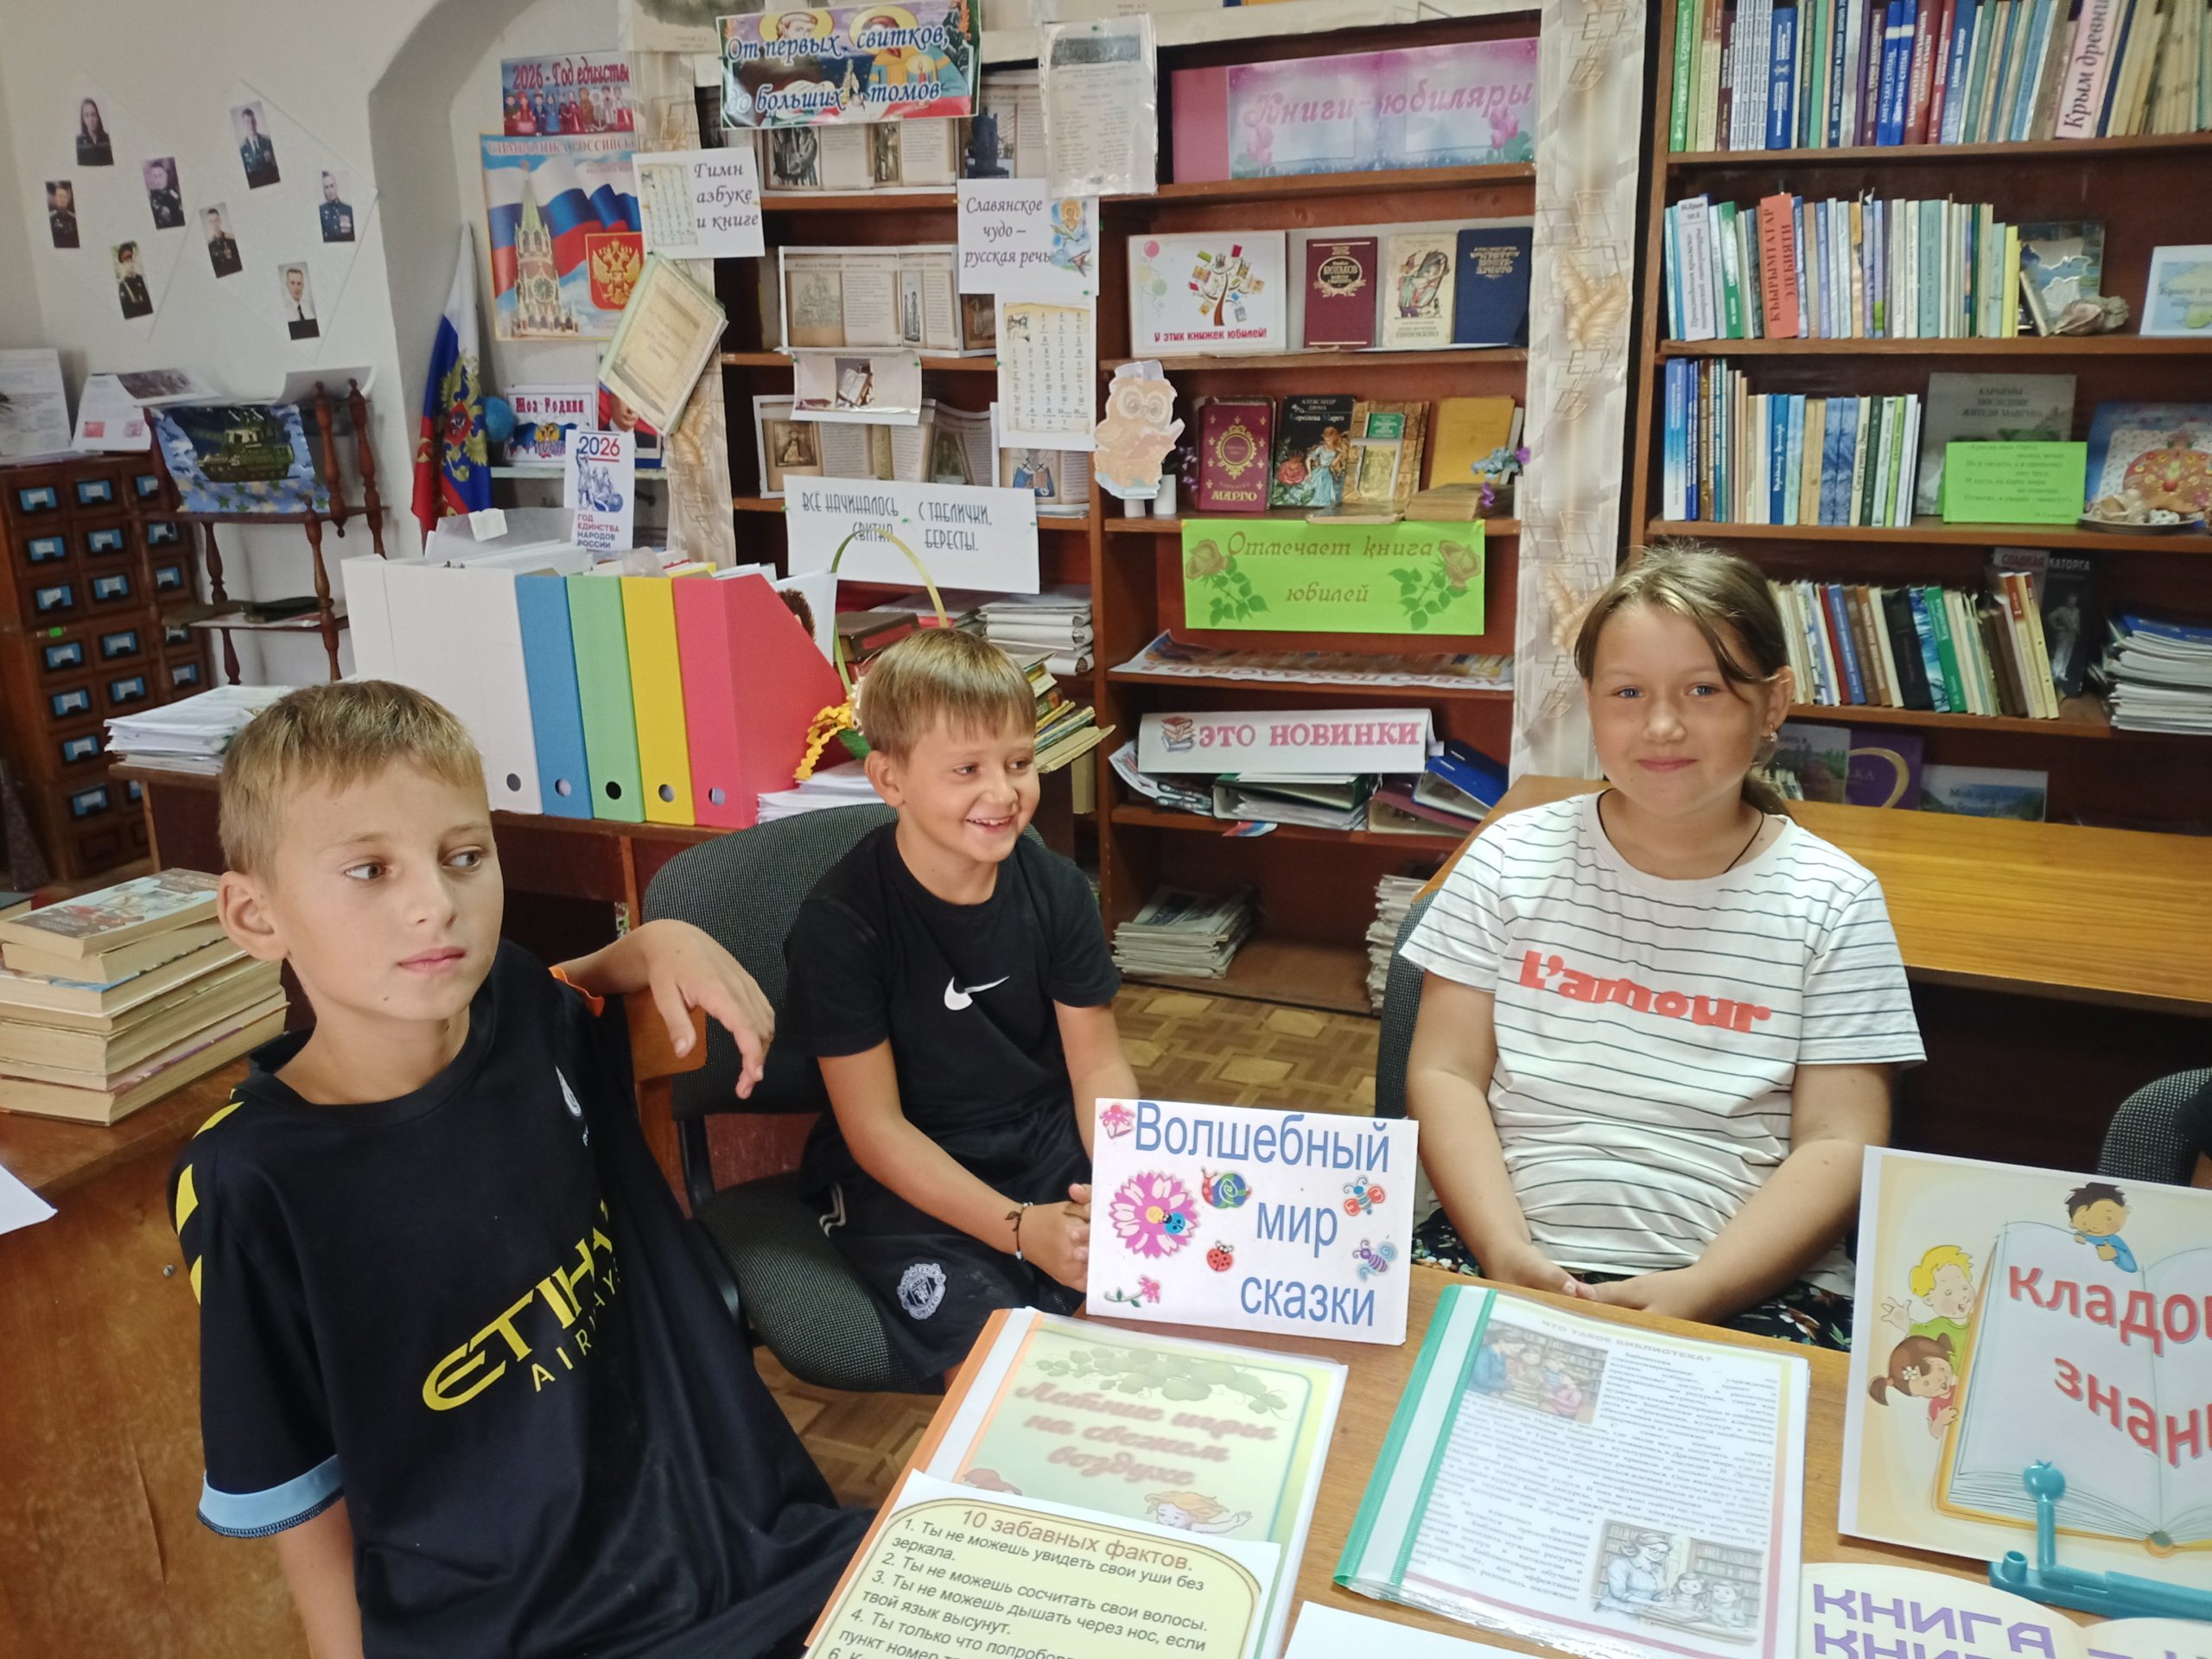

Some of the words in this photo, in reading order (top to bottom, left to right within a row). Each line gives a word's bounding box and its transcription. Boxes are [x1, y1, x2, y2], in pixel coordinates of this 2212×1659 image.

[726, 37, 758, 61] От
[765, 35, 842, 65] первых
[512, 63, 543, 90] 2026
[551, 57, 574, 88] Год
[757, 83, 847, 111] больших
[870, 82, 944, 103] томов
[2063, 72, 2094, 129] Крым
[694, 162, 743, 179] Гимн
[696, 186, 753, 205] азбуке
[966, 197, 1043, 215] Славянское
[696, 217, 706, 228] и
[712, 213, 759, 230] книге
[983, 219, 1013, 243] чудо
[963, 249, 1016, 268] русская
[1019, 251, 1051, 268] речь
[579, 435, 620, 457] 2026
[577, 513, 594, 522] ГОД
[825, 493, 899, 517] НАЧИНАЛОСЬ
[577, 523, 620, 532] ЕДИНСТВА
[577, 531, 616, 541] НАРОДОВ
[577, 540, 612, 549] РОССИИ
[1227, 531, 1351, 556] Отмечает
[1285, 582, 1370, 604] юбилей
[1198, 723, 1256, 748] ЭТО
[1269, 721, 1422, 748] НОВИНКИ
[1519, 950, 1772, 1033] L'amour
[1135, 1101, 1390, 1173] Волшебный
[1255, 1201, 1338, 1259] мир
[1240, 1275, 1376, 1327] сказки
[2009, 1265, 2212, 1358] кладо
[2054, 1357, 2212, 1468] знан
[892, 1536, 957, 1561] зеркала.
[905, 1518, 915, 1531] 1.
[921, 1521, 944, 1538] Ты
[945, 1530, 964, 1543] не
[967, 1535, 1030, 1558] можешь
[1032, 1549, 1096, 1570] увидеть
[1099, 1562, 1137, 1579] свои
[1139, 1571, 1173, 1584] уши
[1176, 1575, 1205, 1592] без
[962, 1510, 988, 1529] 10
[990, 1518, 1101, 1554] забавных
[1105, 1539, 1193, 1572] фактов.
[881, 1552, 896, 1567] 2.
[902, 1555, 925, 1573] Ты
[926, 1566, 947, 1579] не
[949, 1572, 1014, 1594] можешь
[1016, 1585, 1096, 1611] сосчитать
[1100, 1602, 1140, 1618] свои
[1142, 1610, 1208, 1632] волосы.
[861, 1590, 899, 1609] твой
[900, 1600, 940, 1620] язык
[942, 1611, 1013, 1636] высунут.
[871, 1569, 885, 1585] 3.
[892, 1573, 915, 1592] Ты
[917, 1584, 938, 1598] не
[939, 1590, 1006, 1612] можешь
[1007, 1604, 1072, 1626] дышать
[1077, 1617, 1124, 1637] через
[1127, 1626, 1160, 1645] нос,
[1166, 1634, 1207, 1652] если
[1814, 1583, 2056, 1659] КНИГА
[839, 1629, 886, 1650] пункт
[849, 1608, 864, 1624] 4.
[871, 1611, 894, 1630] Ты
[898, 1622, 952, 1645] только
[955, 1636, 983, 1651] что
